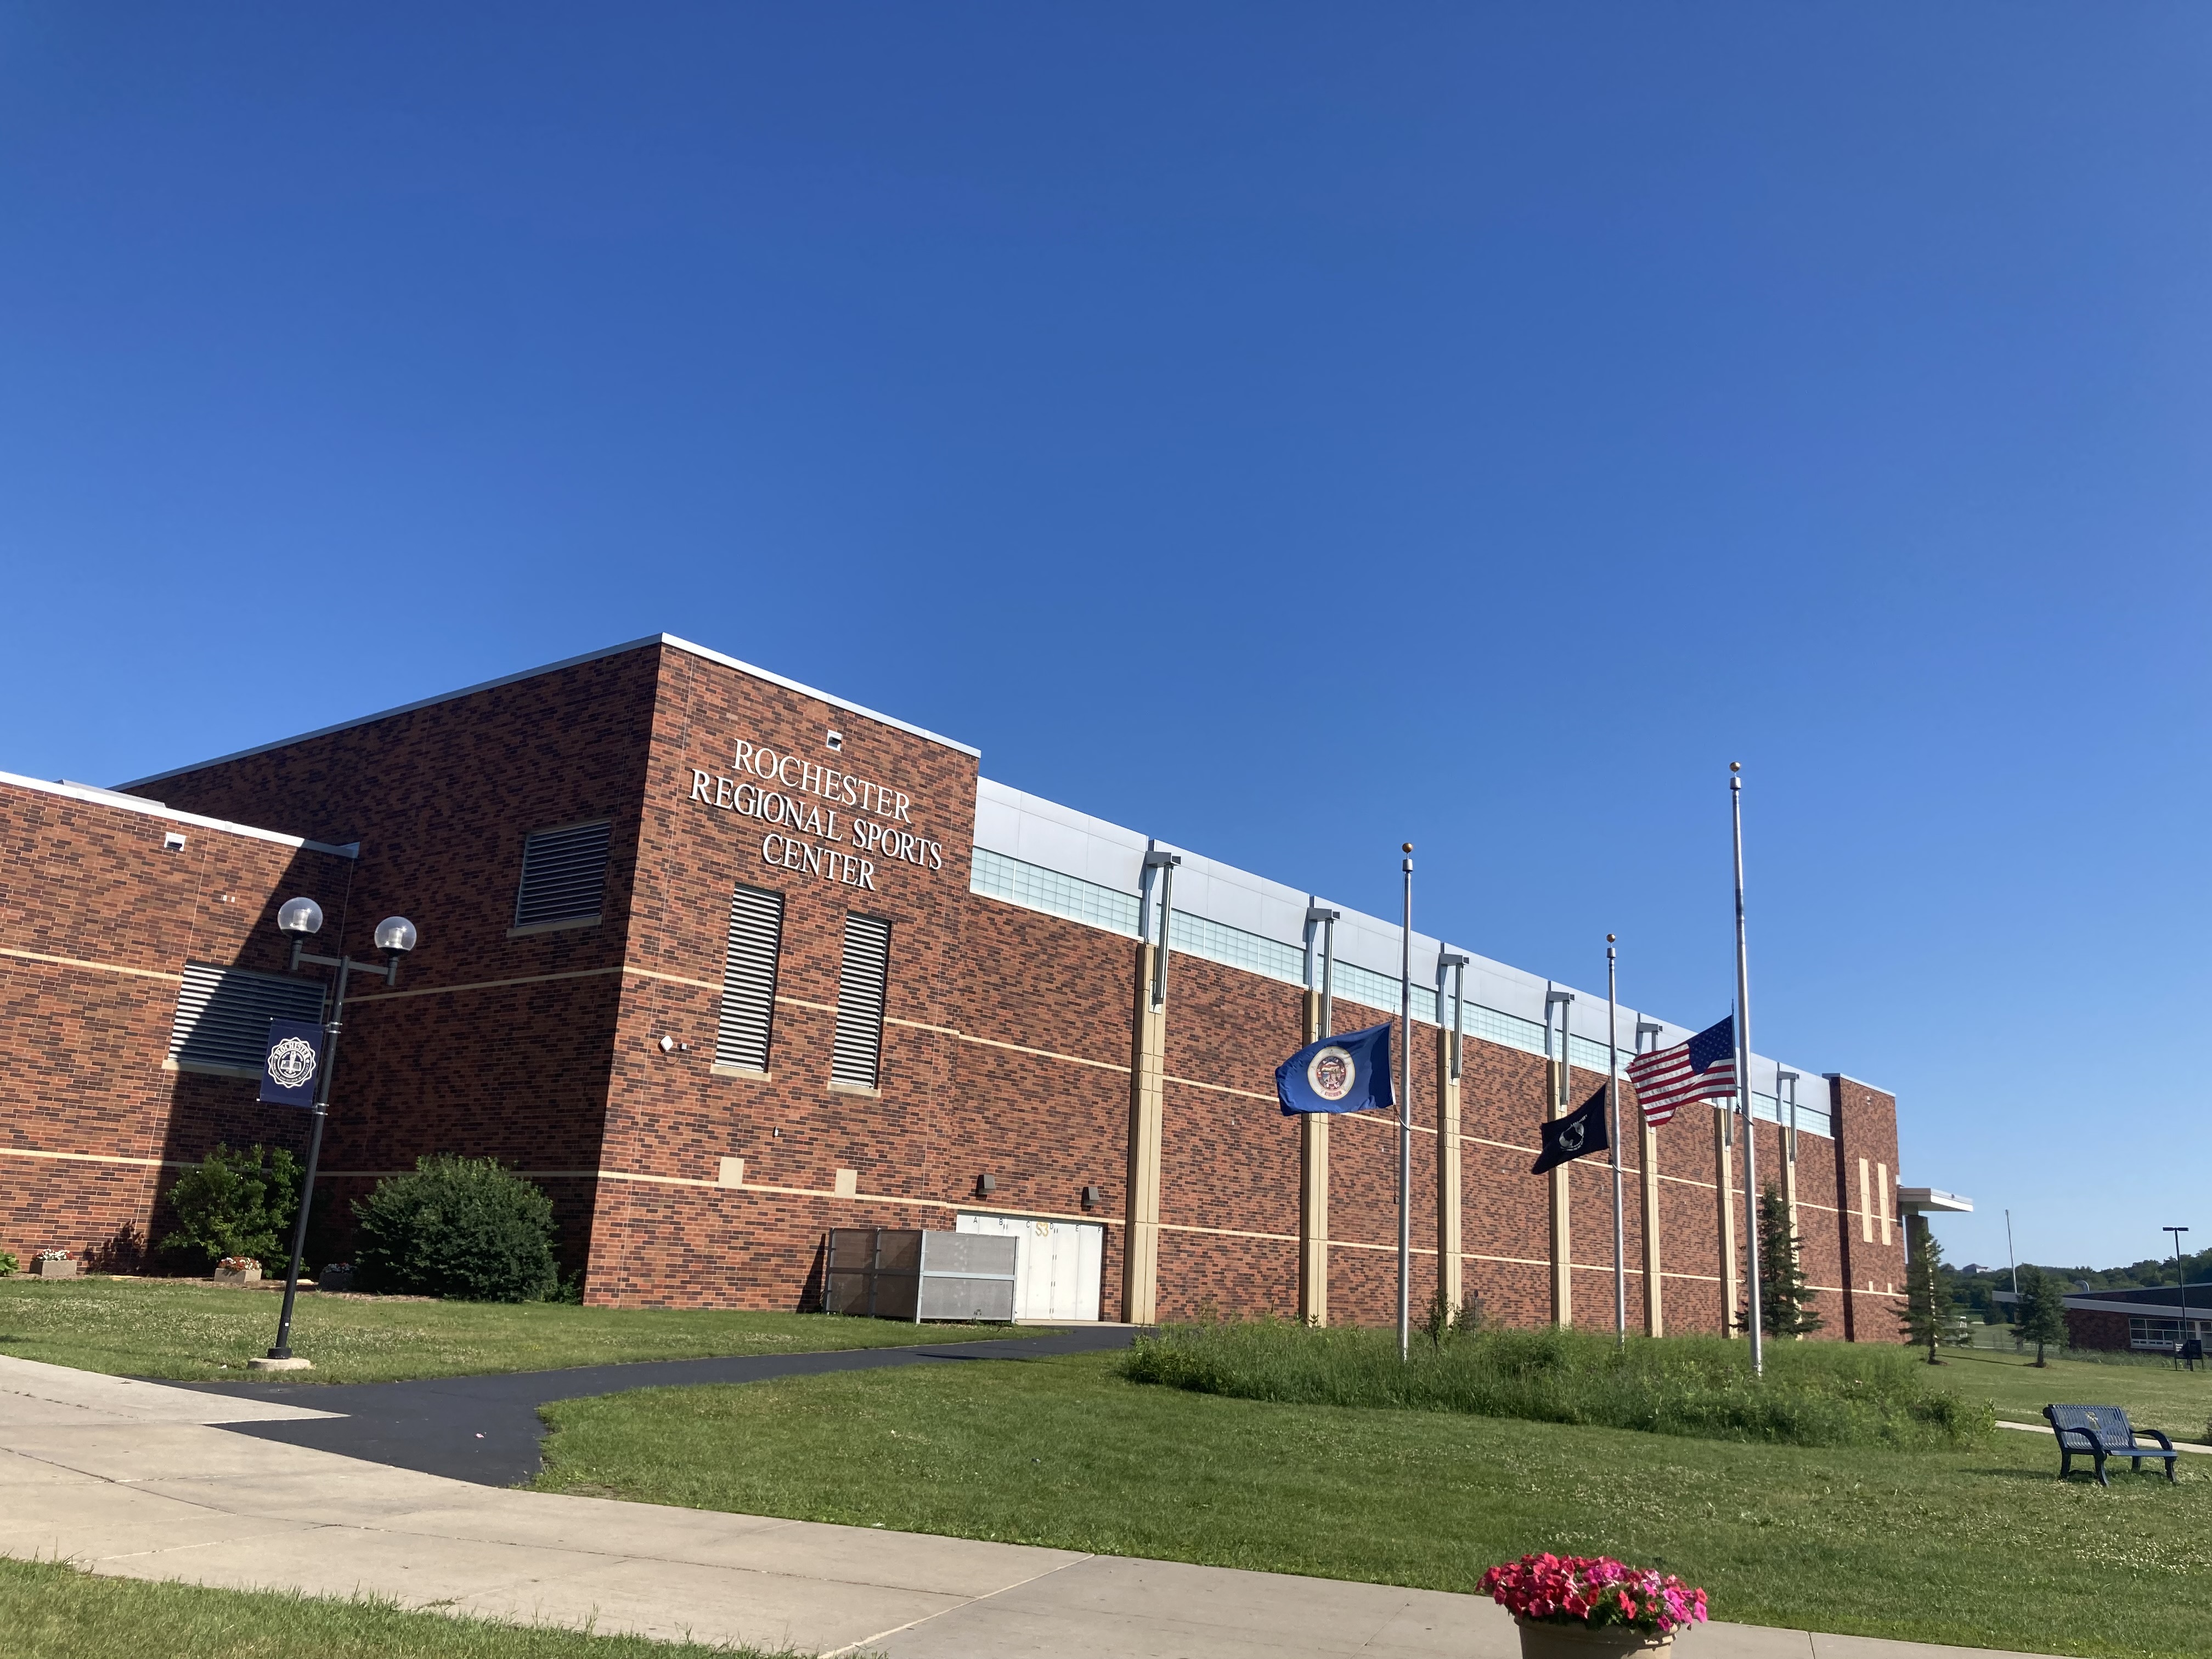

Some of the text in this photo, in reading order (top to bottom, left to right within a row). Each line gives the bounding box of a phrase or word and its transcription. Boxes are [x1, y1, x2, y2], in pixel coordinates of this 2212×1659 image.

[732, 738, 912, 823] ROCHESTER
[689, 768, 943, 870] REGIONAL SPORTS
[762, 833, 876, 891] CENTER
[275, 1042, 311, 1059] ROCHESTER
[1035, 1221, 1049, 1237] S3
